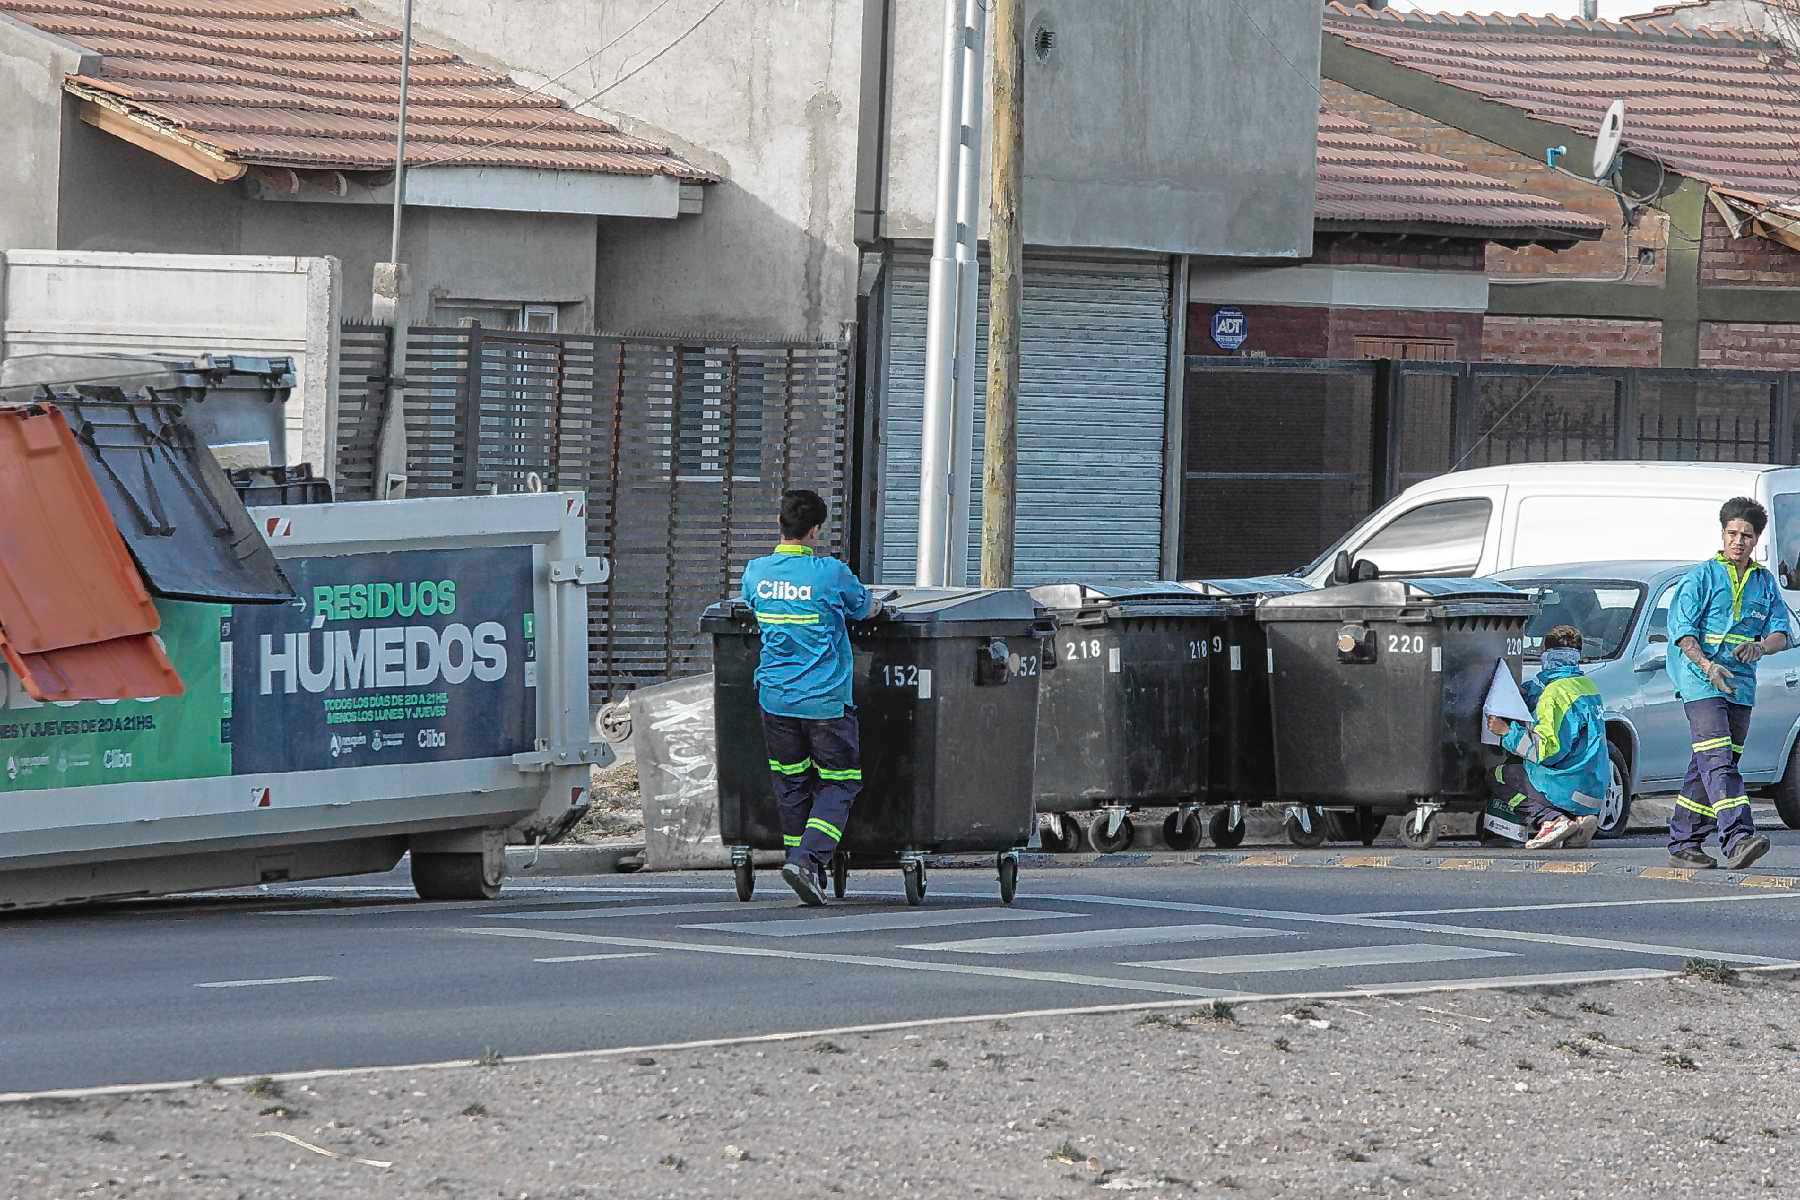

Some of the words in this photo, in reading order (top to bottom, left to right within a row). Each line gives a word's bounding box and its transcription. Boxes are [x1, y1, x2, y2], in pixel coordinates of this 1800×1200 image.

[1217, 318, 1243, 334] ADT
[756, 580, 812, 600] Cliba
[313, 580, 456, 621] RESIDUOS
[1066, 639, 1101, 660] 218
[1189, 640, 1208, 659] 218
[1388, 634, 1424, 654] 220
[1506, 638, 1522, 655] 220
[259, 615, 508, 695] HÚMEDOS
[882, 664, 919, 687] 152
[1013, 655, 1037, 677] 52
[353, 696, 369, 709] LOS
[391, 694, 404, 706] DE
[405, 707, 412, 719] Y
[412, 705, 447, 718] JUEVES
[20, 723, 30, 737] Y
[31, 719, 80, 737] JUEVES
[81, 718, 96, 733] DE
[95, 717, 114, 733] 20
[114, 716, 122, 731] A
[123, 715, 136, 730] 21
[417, 728, 446, 748] Cliba
